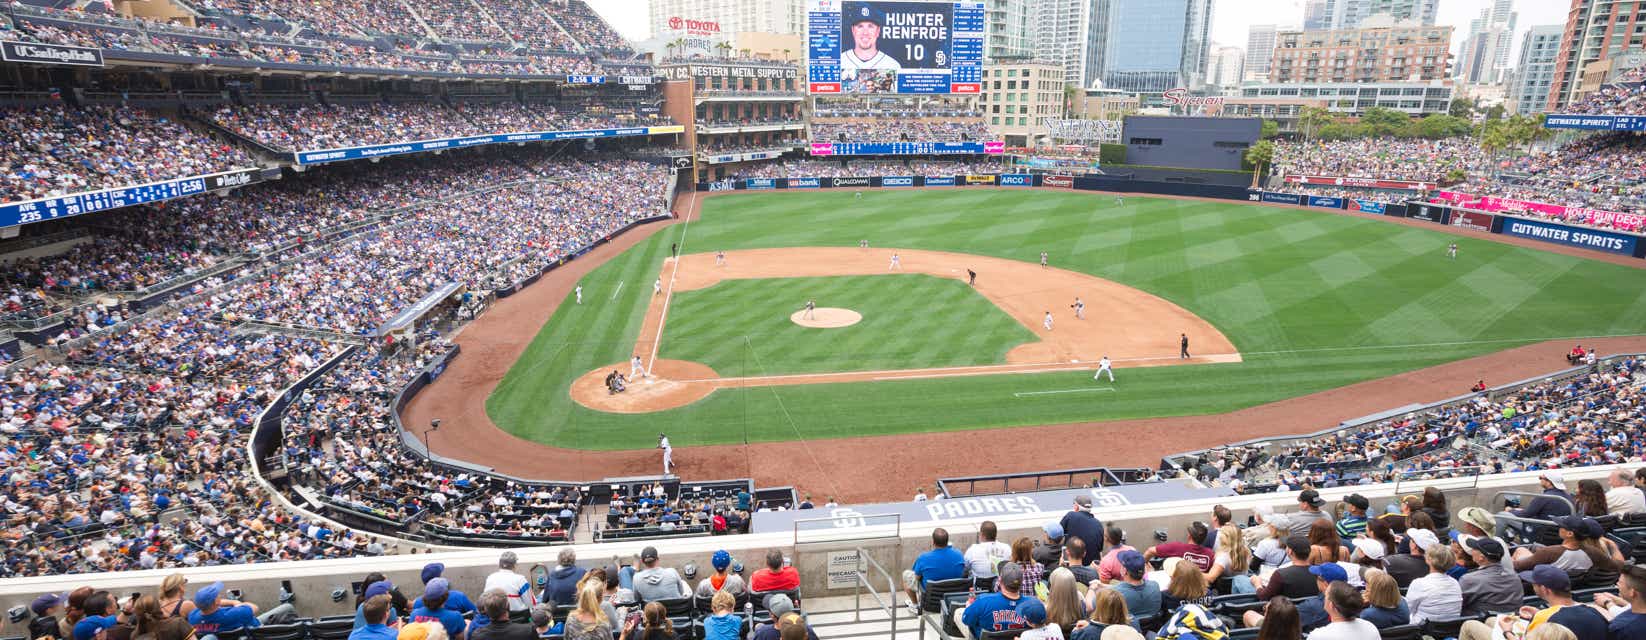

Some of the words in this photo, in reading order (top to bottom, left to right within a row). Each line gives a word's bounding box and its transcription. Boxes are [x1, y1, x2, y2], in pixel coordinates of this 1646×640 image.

[685, 20, 720, 32] TOYOTA
[885, 13, 944, 26] HUNTER
[882, 26, 947, 39] RENFROE
[905, 44, 924, 60] 10
[691, 66, 729, 77] WESTERN
[731, 67, 757, 78] METAL
[757, 68, 784, 79] SUPPLY
[786, 69, 797, 79] CO.
[1548, 118, 1580, 126] CUTWATER
[1582, 118, 1610, 127] SPIRITS
[709, 182, 735, 191] ASML
[1002, 176, 1024, 184] ARCO
[181, 181, 202, 193] 2:56
[18, 211, 41, 223] .235
[50, 208, 58, 217] 9
[67, 204, 80, 214] 20
[19, 202, 36, 212] AVG
[1593, 210, 1614, 225] RUN
[1511, 222, 1568, 241] CUTWATER
[1571, 232, 1624, 250] SPIRITS
[926, 495, 1042, 521] PADRES
